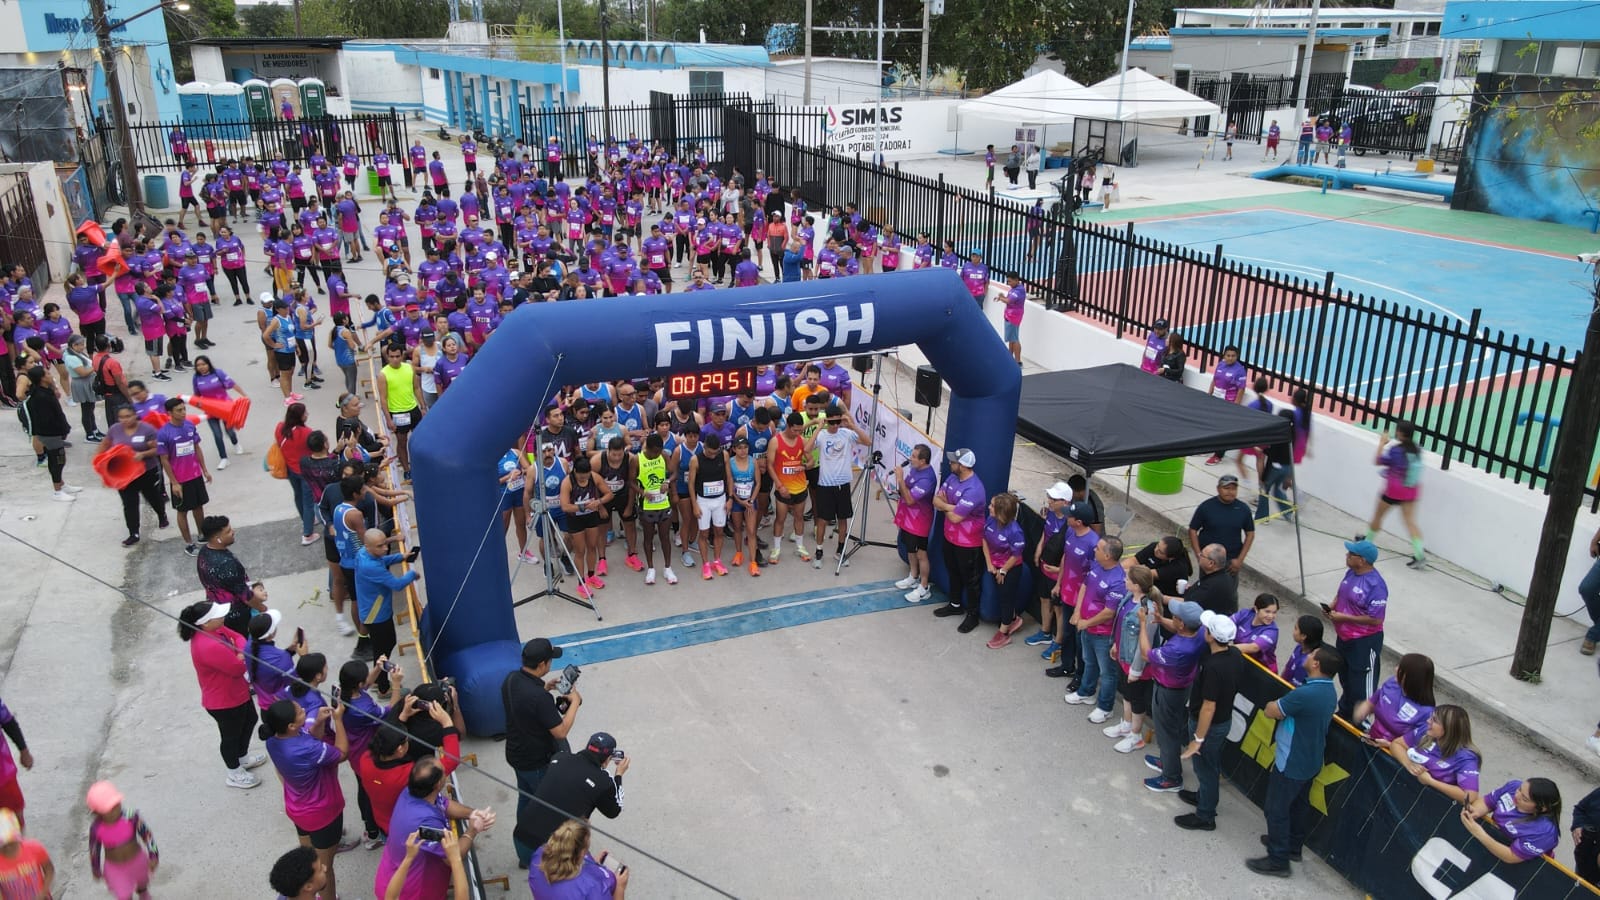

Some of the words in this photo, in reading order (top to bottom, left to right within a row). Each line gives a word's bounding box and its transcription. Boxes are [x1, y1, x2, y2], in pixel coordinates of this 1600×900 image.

[848, 140, 907, 153] POTABILZADORA
[654, 302, 875, 368] FINISH
[671, 375, 696, 396] 00
[700, 373, 724, 394] 29
[862, 410, 887, 439] SIAS
